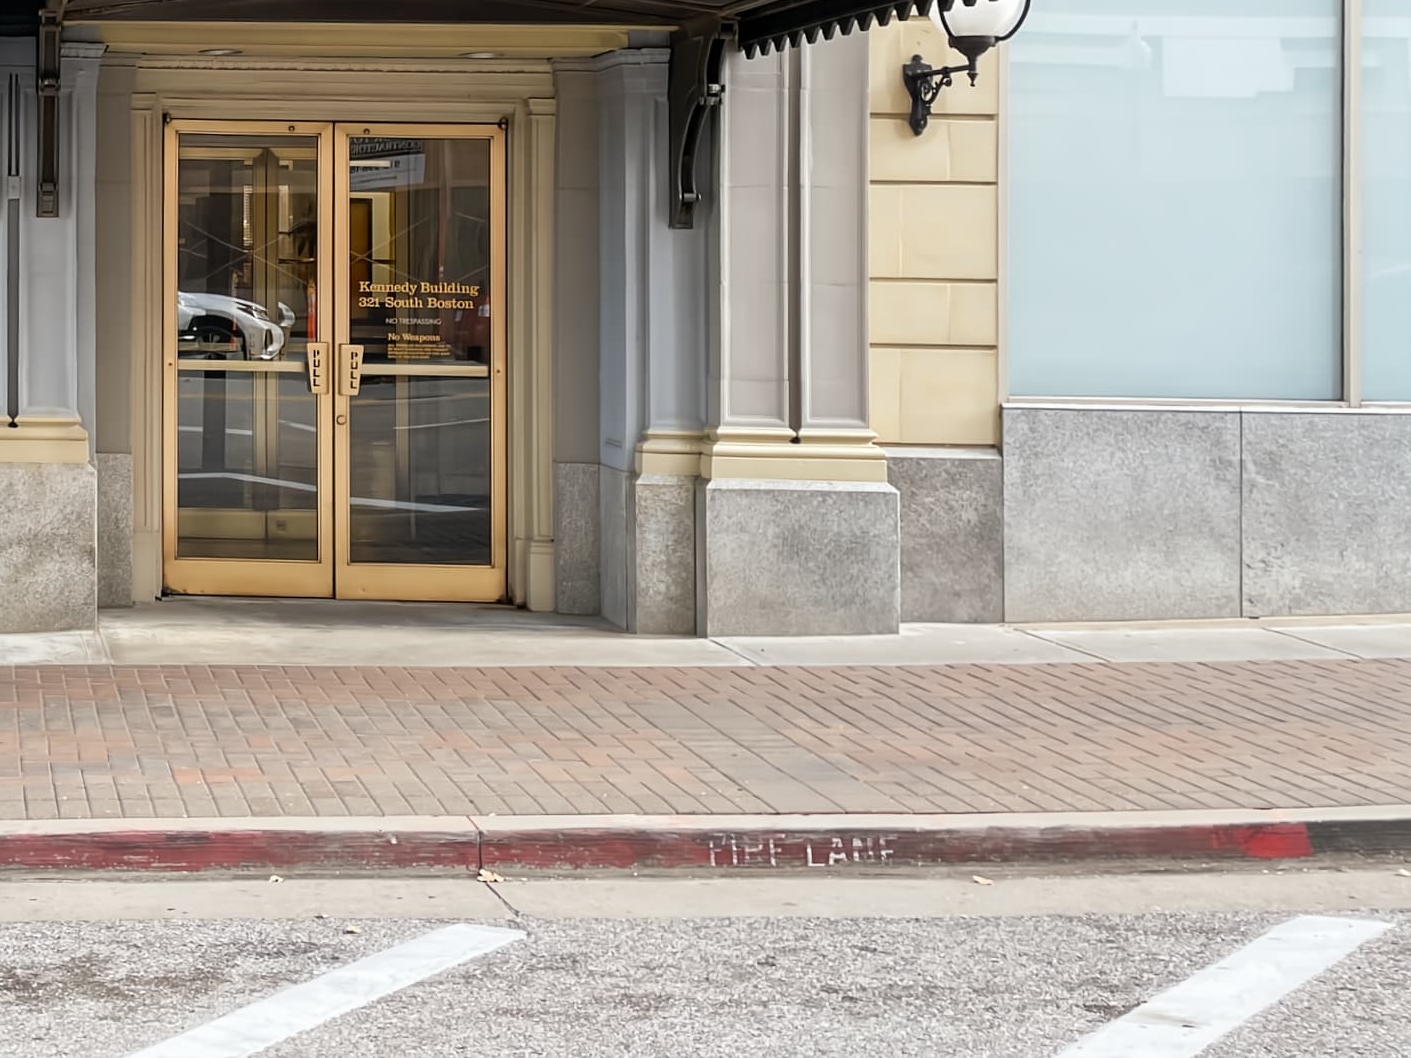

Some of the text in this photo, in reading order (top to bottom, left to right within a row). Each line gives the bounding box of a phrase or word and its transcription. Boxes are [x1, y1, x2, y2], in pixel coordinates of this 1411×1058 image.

[358, 281, 480, 296] Kennedy Building
[358, 296, 474, 309] 321 South Boston
[387, 333, 441, 343] No Weapons
[312, 349, 321, 387] PULL
[350, 351, 358, 389] PULL
